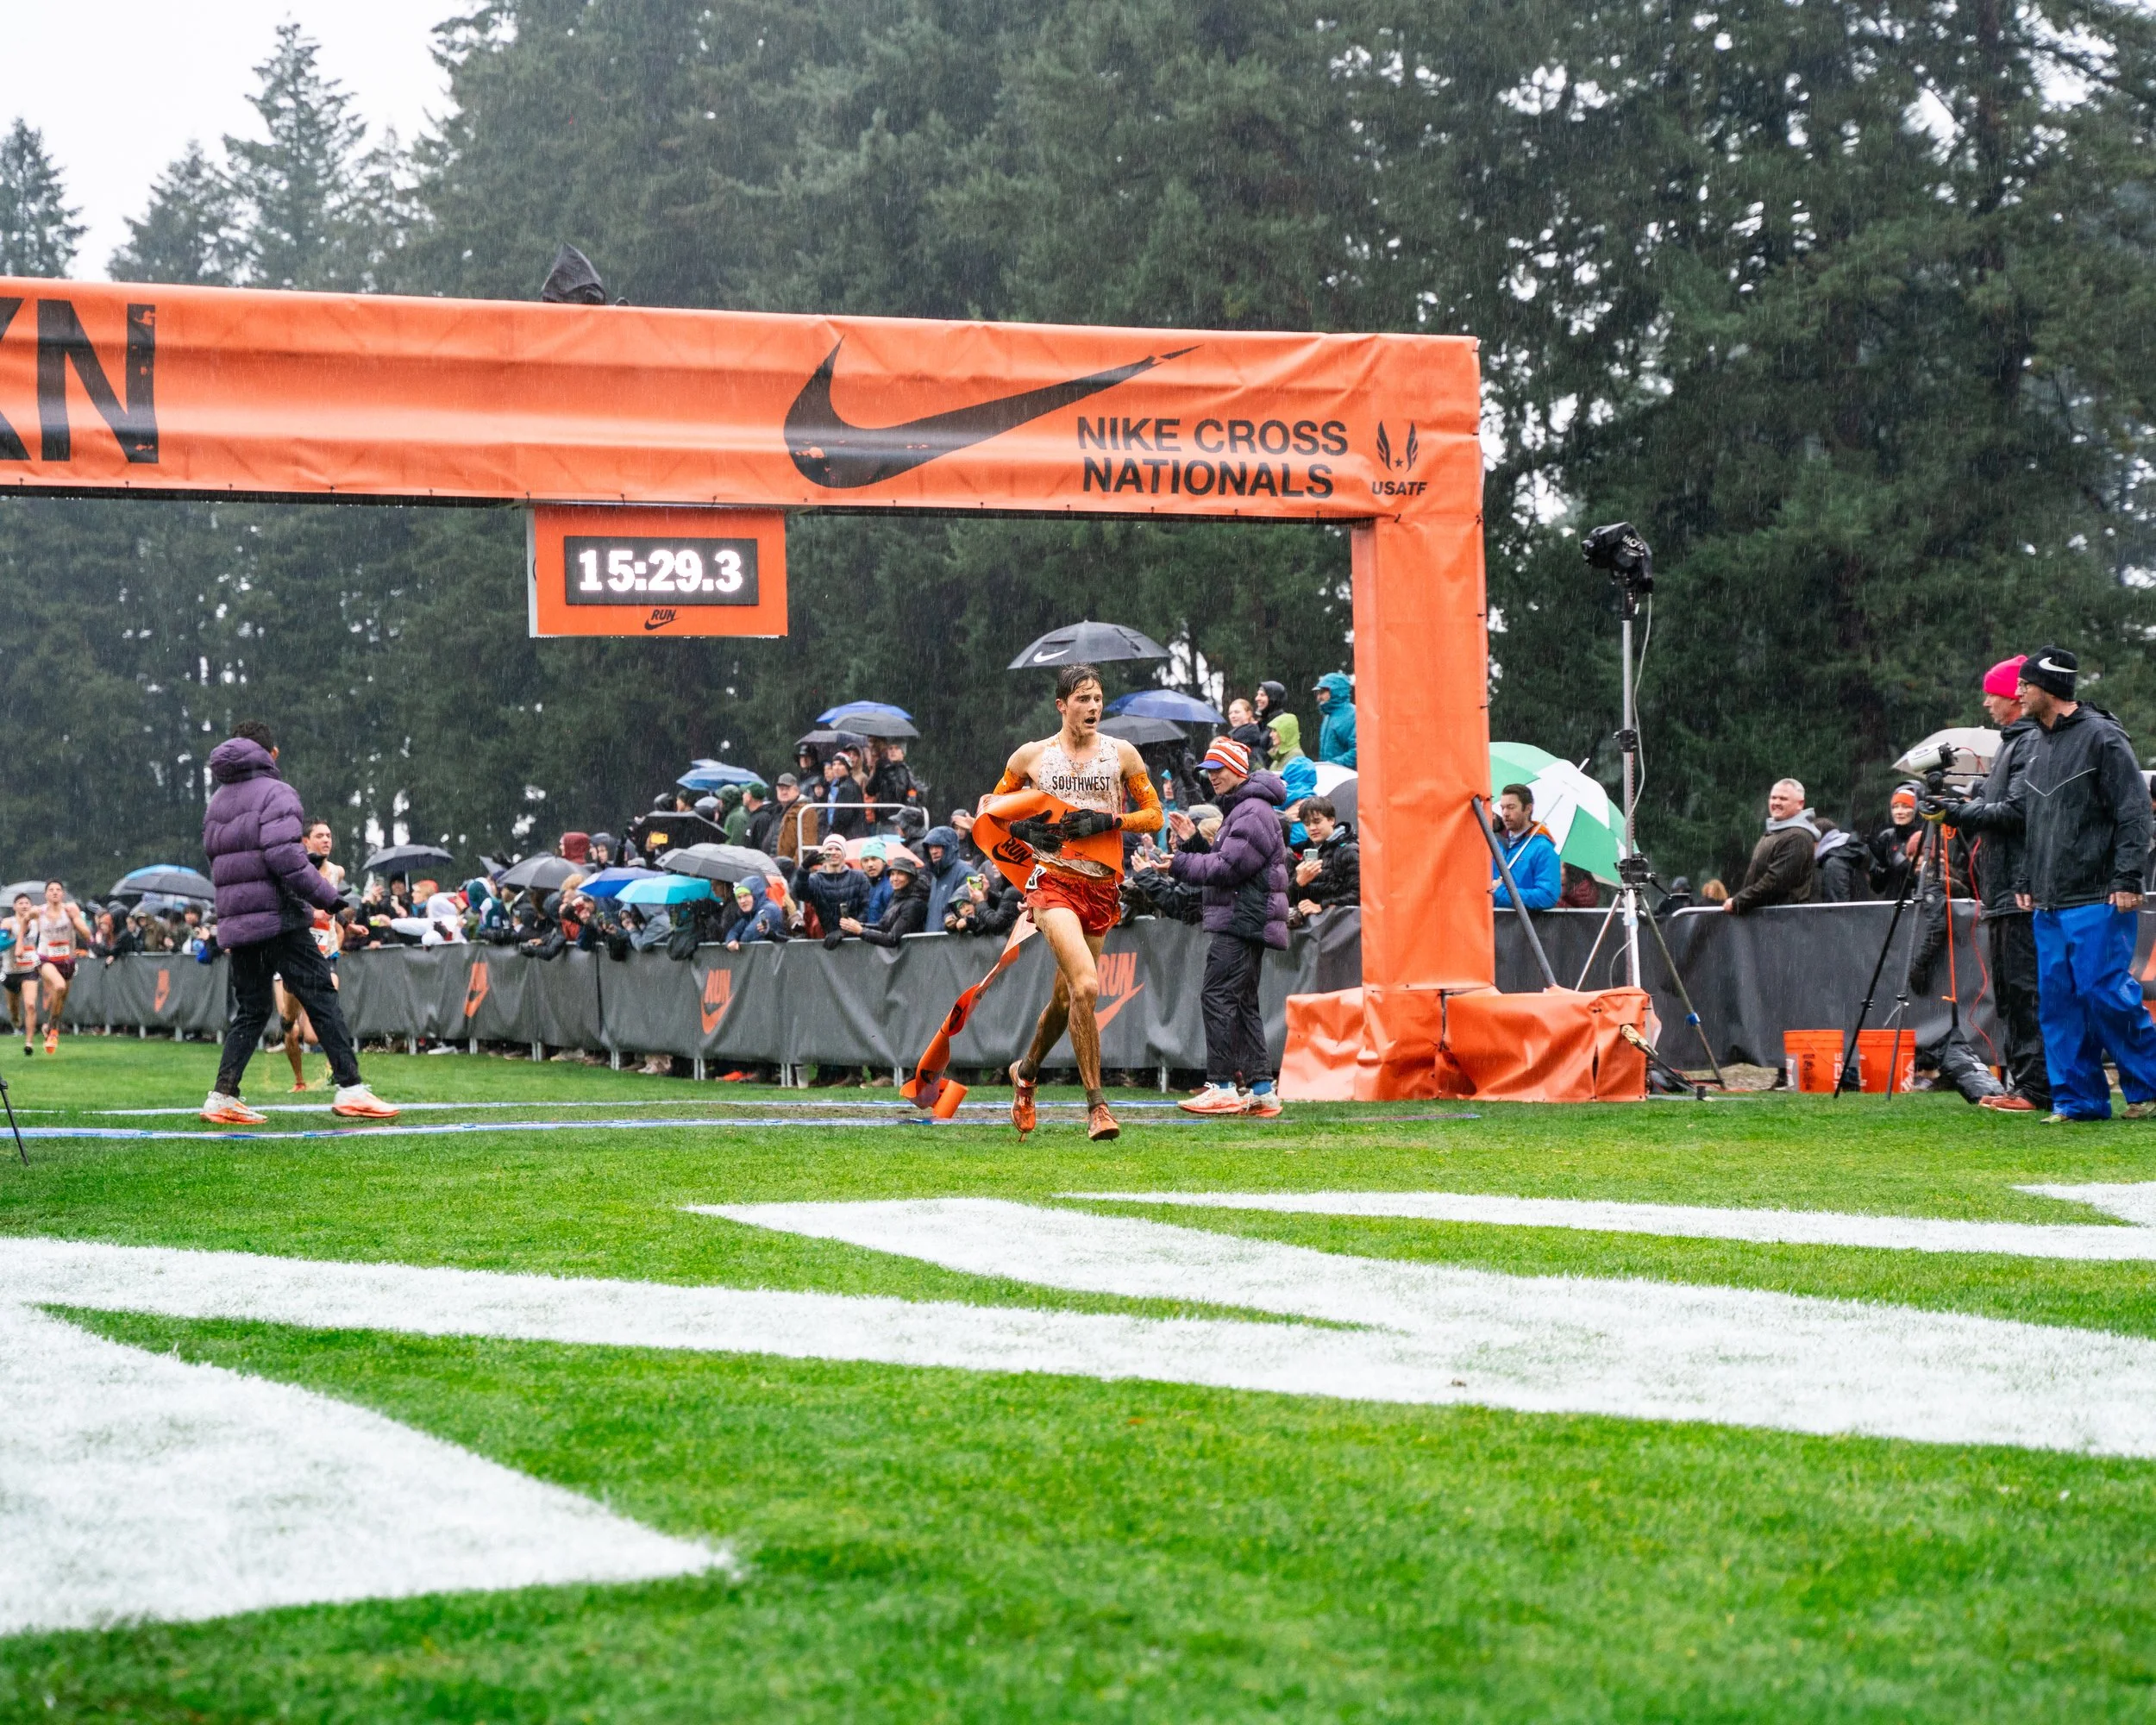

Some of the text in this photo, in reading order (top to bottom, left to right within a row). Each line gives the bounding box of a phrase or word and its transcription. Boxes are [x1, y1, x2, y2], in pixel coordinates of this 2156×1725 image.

[1077, 416, 1349, 456] NIKE CROSS
[1082, 456, 1335, 499] NATIONALS
[1371, 480, 1429, 497] USATF
[579, 549, 743, 593] 15:29.3
[650, 609, 677, 621] RUN
[1051, 775, 1111, 792] SOUTHWEST
[1000, 837, 1033, 864] RUN
[1097, 951, 1138, 997] RUN
